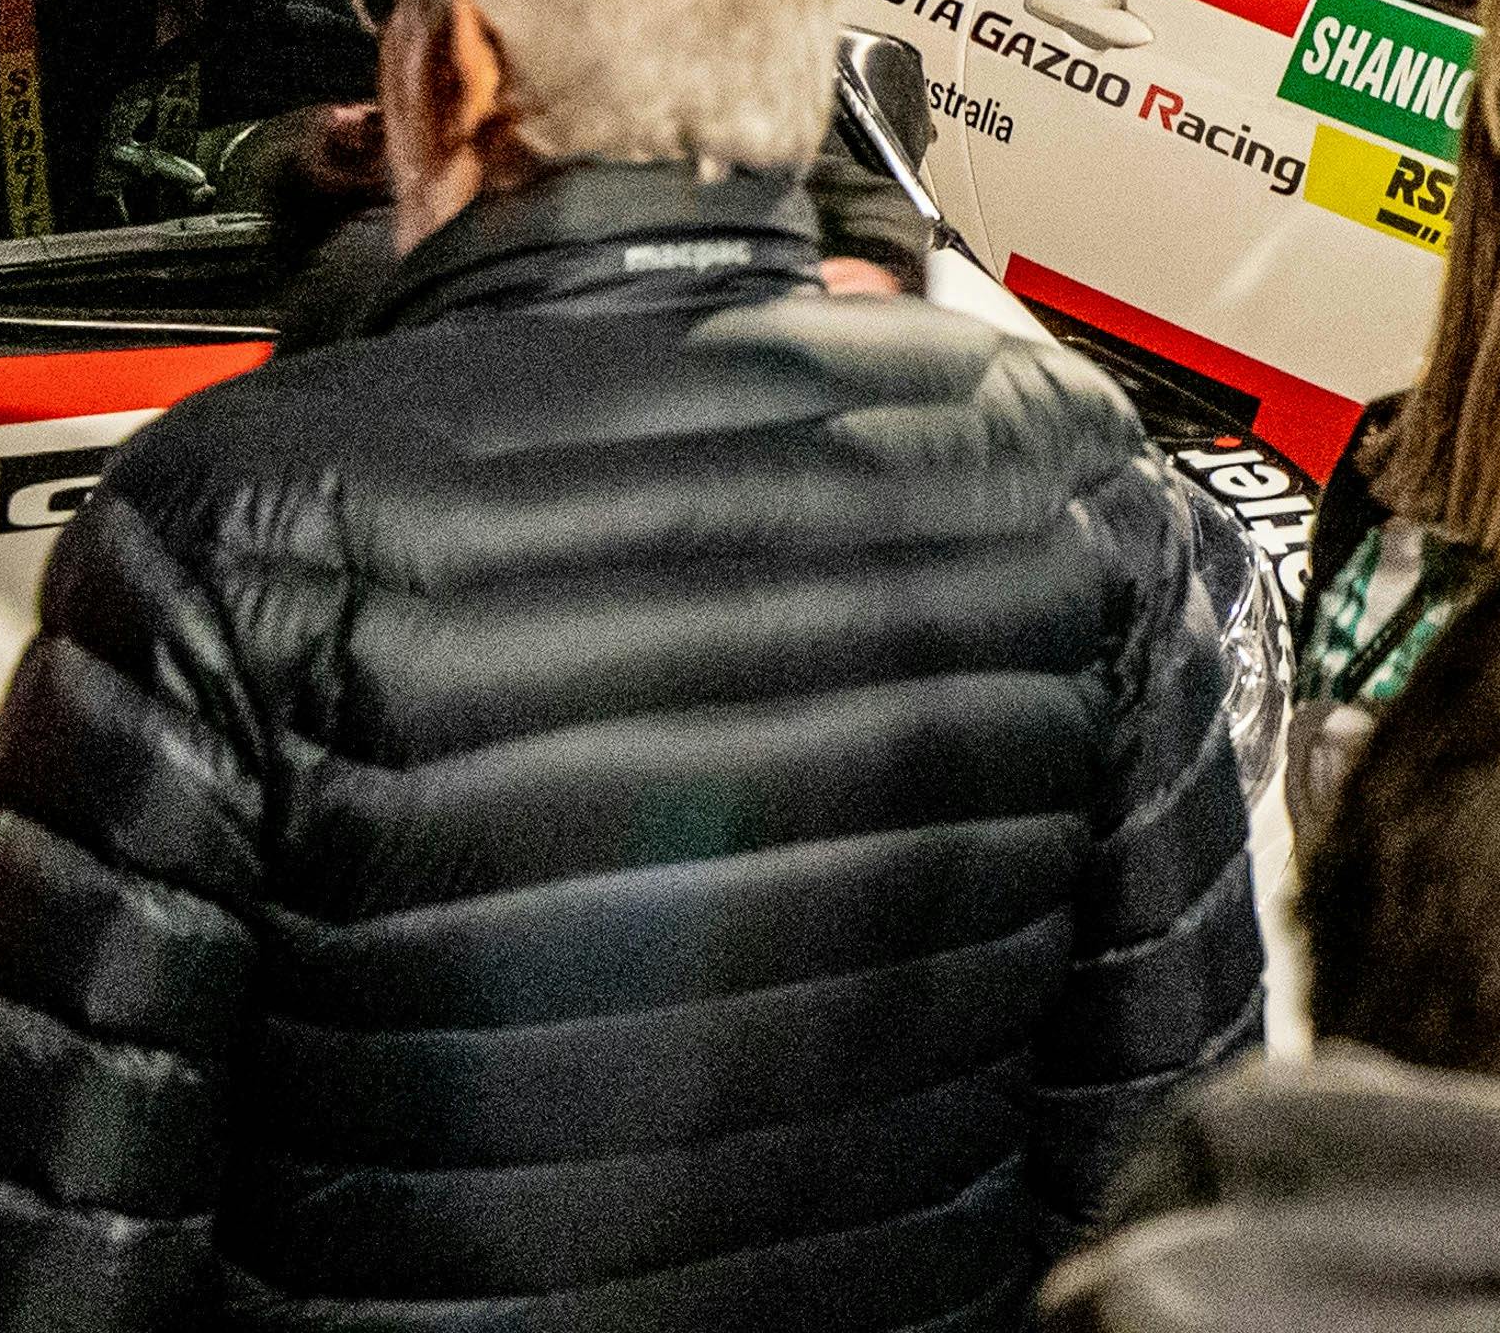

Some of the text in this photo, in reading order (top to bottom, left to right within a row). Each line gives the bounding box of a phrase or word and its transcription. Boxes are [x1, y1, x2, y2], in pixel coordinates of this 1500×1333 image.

[925, 77, 1014, 145] stralia
[1138, 82, 1307, 197] Racing
[1385, 154, 1456, 220] RS
